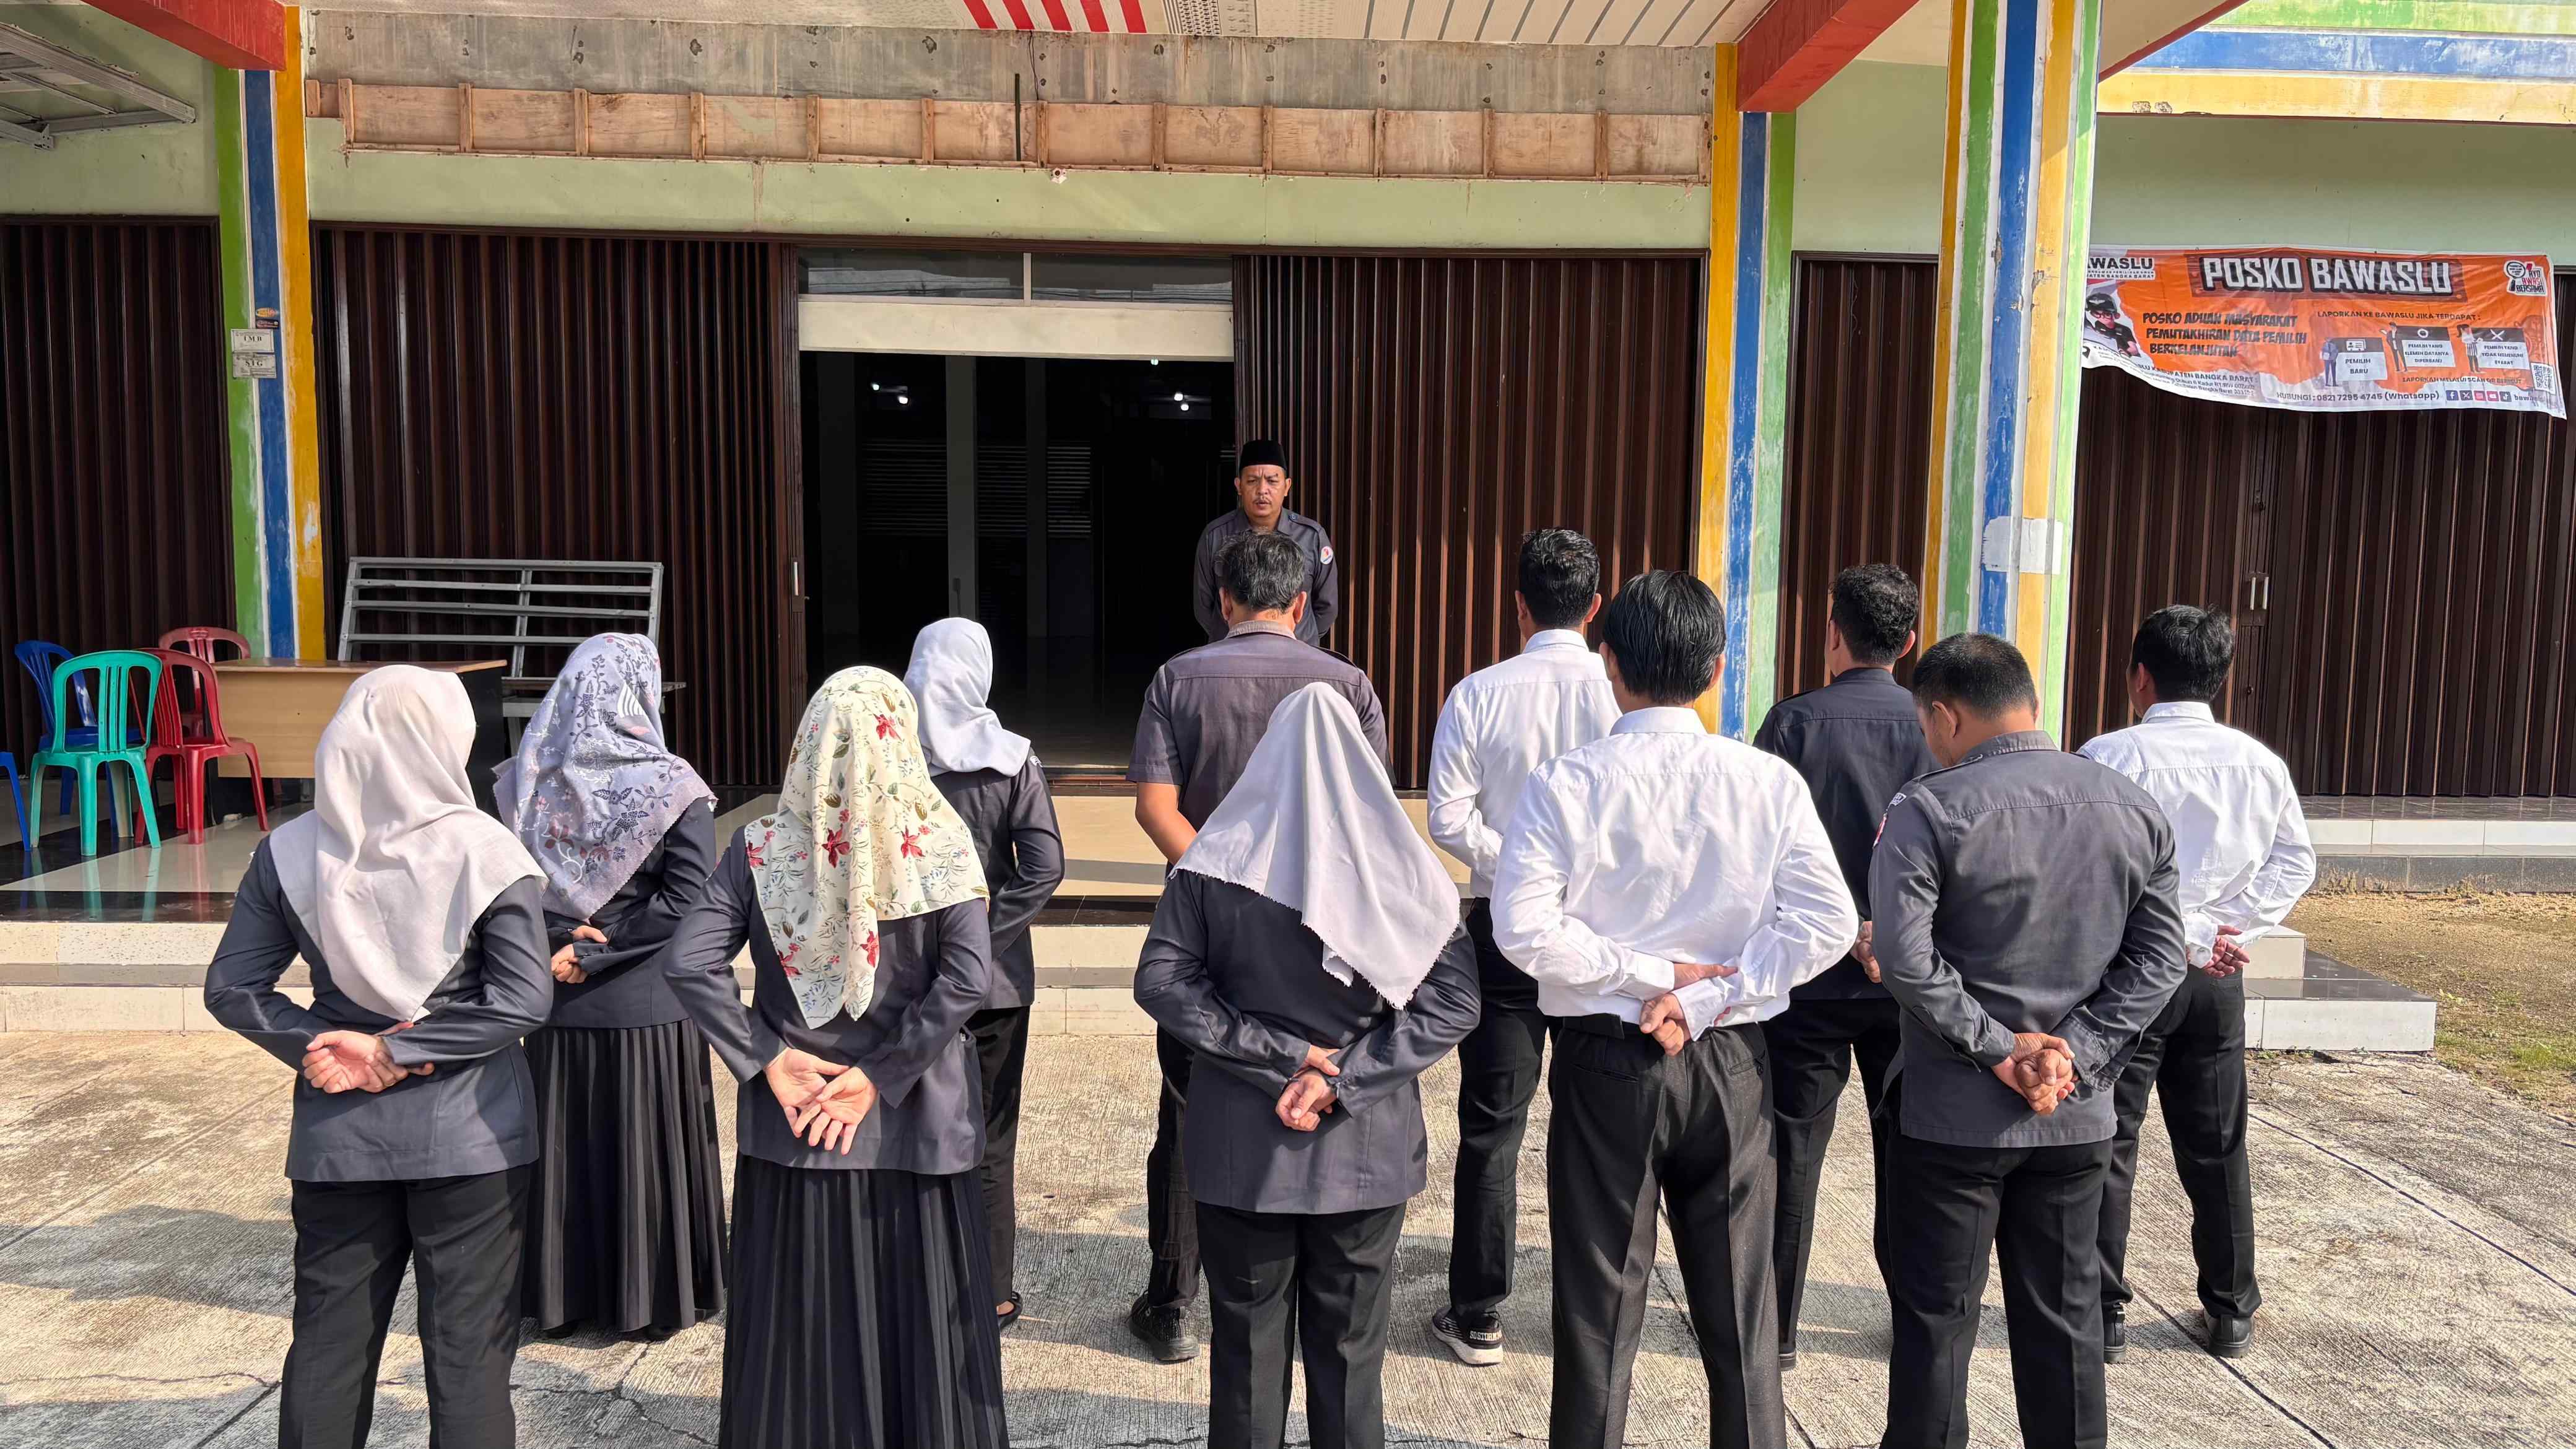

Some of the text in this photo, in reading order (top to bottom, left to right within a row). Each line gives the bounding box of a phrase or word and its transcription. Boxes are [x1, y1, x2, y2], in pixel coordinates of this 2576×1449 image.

[2202, 257, 2452, 294] POSKO BAWASLU
[2143, 312, 2298, 327] POSKO ADUAN MASYARAKAT
[2146, 328, 2307, 344] PEMUTAKHIRAN DATA PEMILIH
[2149, 343, 2237, 357] BERKELANJUTAN
[2277, 392, 2311, 401] HUBUNGI
[2385, 391, 2439, 401] (Whatsapp)
